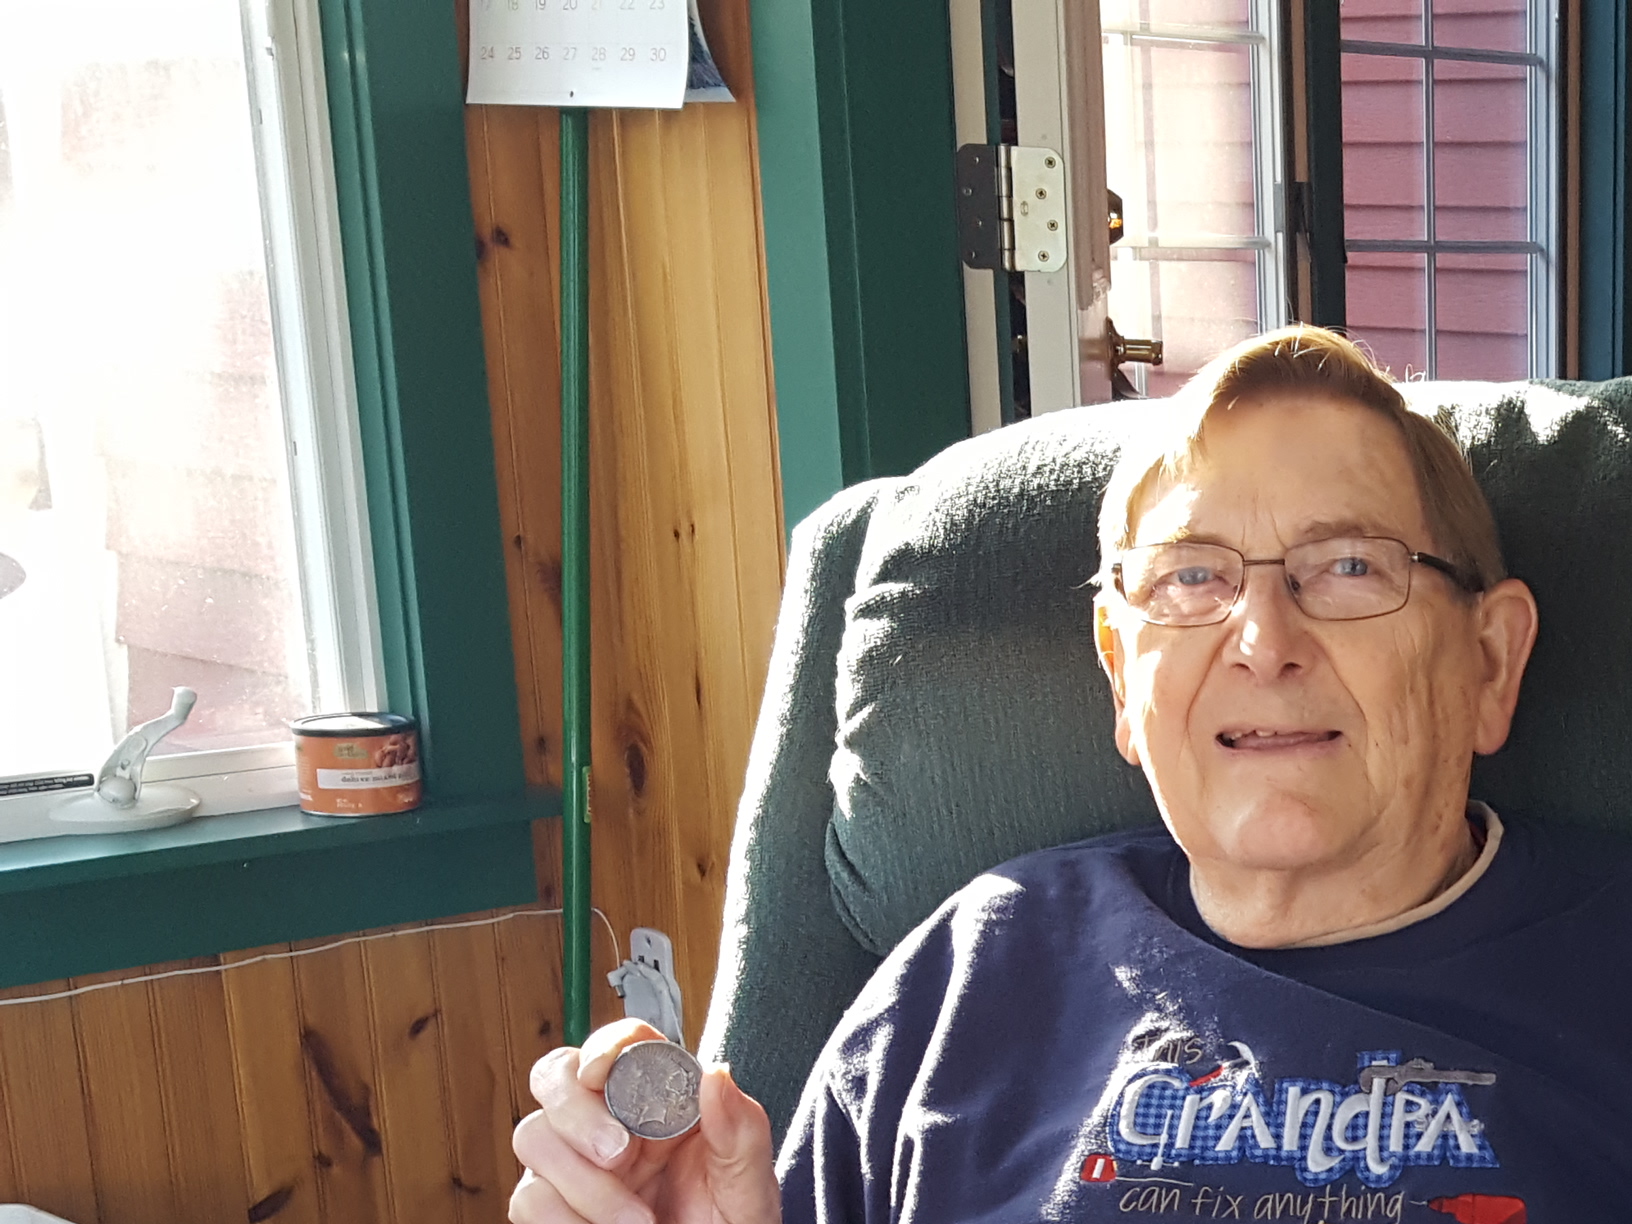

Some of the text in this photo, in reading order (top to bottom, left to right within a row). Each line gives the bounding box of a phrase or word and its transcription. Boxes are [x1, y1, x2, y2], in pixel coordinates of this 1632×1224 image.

[480, 46, 666, 62] 24 25 26 27 28 29 30
[1119, 1185, 1179, 1213] can
[1192, 1187, 1242, 1219] fix
